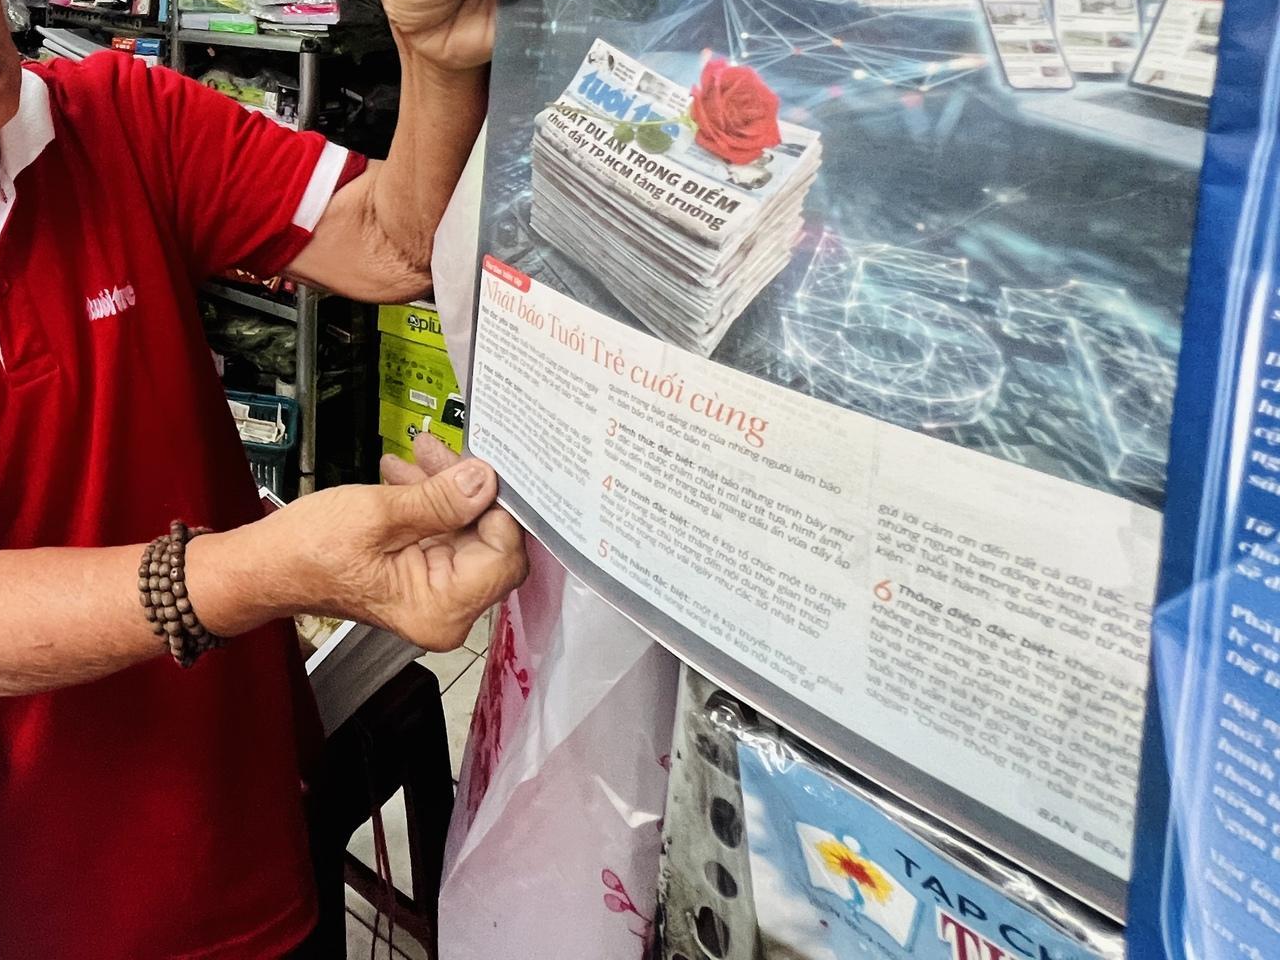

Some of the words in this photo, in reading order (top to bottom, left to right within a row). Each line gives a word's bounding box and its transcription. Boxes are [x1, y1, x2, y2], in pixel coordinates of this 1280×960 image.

[517, 296, 545, 330] báo
[548, 312, 586, 355] Tuổi
[589, 334, 625, 376] Trẻ
[630, 362, 686, 405] cuối
[689, 388, 770, 449] cùng
[606, 418, 618, 437] 3
[601, 474, 613, 492] 4
[597, 538, 609, 558] 5
[873, 579, 893, 602] 6
[893, 849, 988, 921] TẠP
